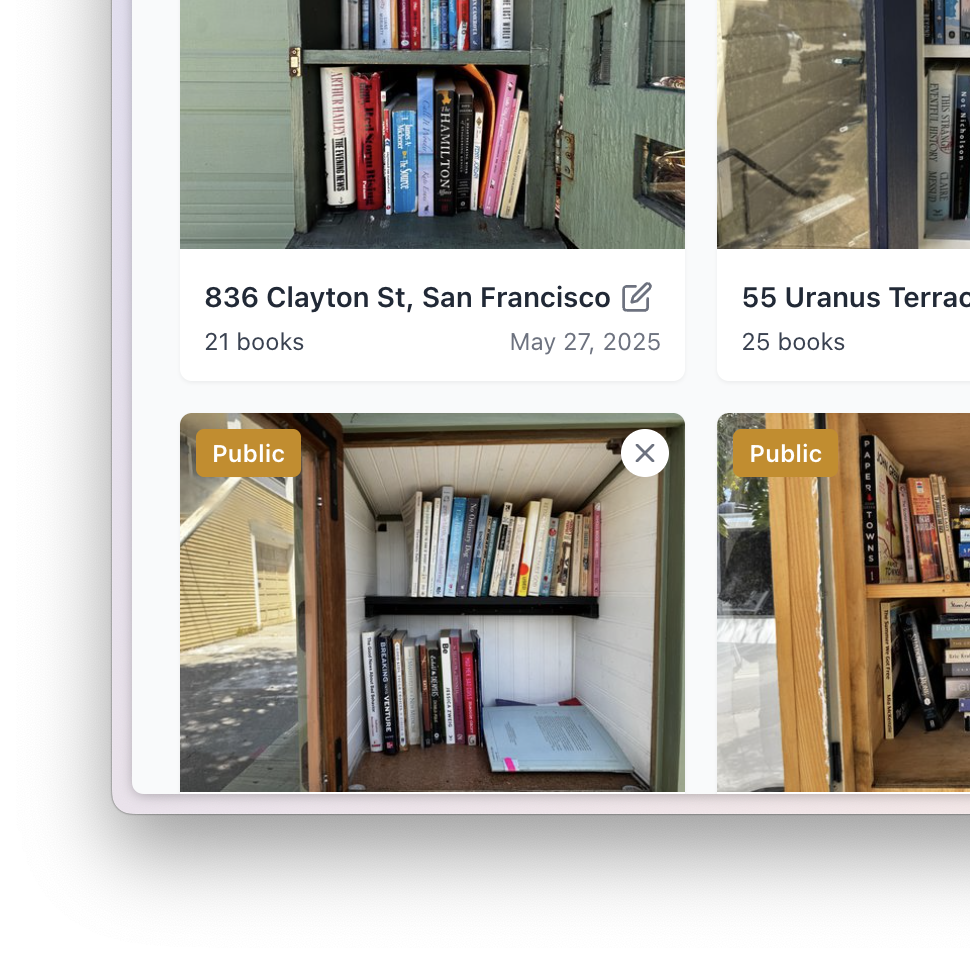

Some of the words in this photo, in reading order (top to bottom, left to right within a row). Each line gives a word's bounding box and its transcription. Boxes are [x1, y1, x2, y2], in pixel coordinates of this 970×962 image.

[331, 72, 343, 108] ARTHUR
[332, 108, 344, 136] HAILEY
[335, 138, 344, 148] THE
[958, 112, 967, 162] Nicholson
[334, 148, 344, 176] EVENING
[440, 111, 450, 189] HAMILTON
[335, 176, 345, 192] NEWS
[205, 286, 258, 308] 836
[267, 286, 368, 313] Clayton
[378, 286, 412, 313] St,
[423, 286, 471, 308] San
[482, 285, 610, 308] Francisco
[743, 287, 776, 308] 55
[786, 287, 880, 308] Uranus
[205, 332, 227, 350] 21
[238, 332, 304, 351] books
[511, 333, 556, 355] May
[565, 332, 593, 355] 27,
[604, 332, 660, 351] 2025
[743, 332, 769, 351] 25
[779, 332, 845, 351] books
[214, 443, 284, 463] Public
[751, 443, 821, 463] Public
[380, 642, 389, 682] BREAKING
[384, 694, 392, 733] VENTURE
